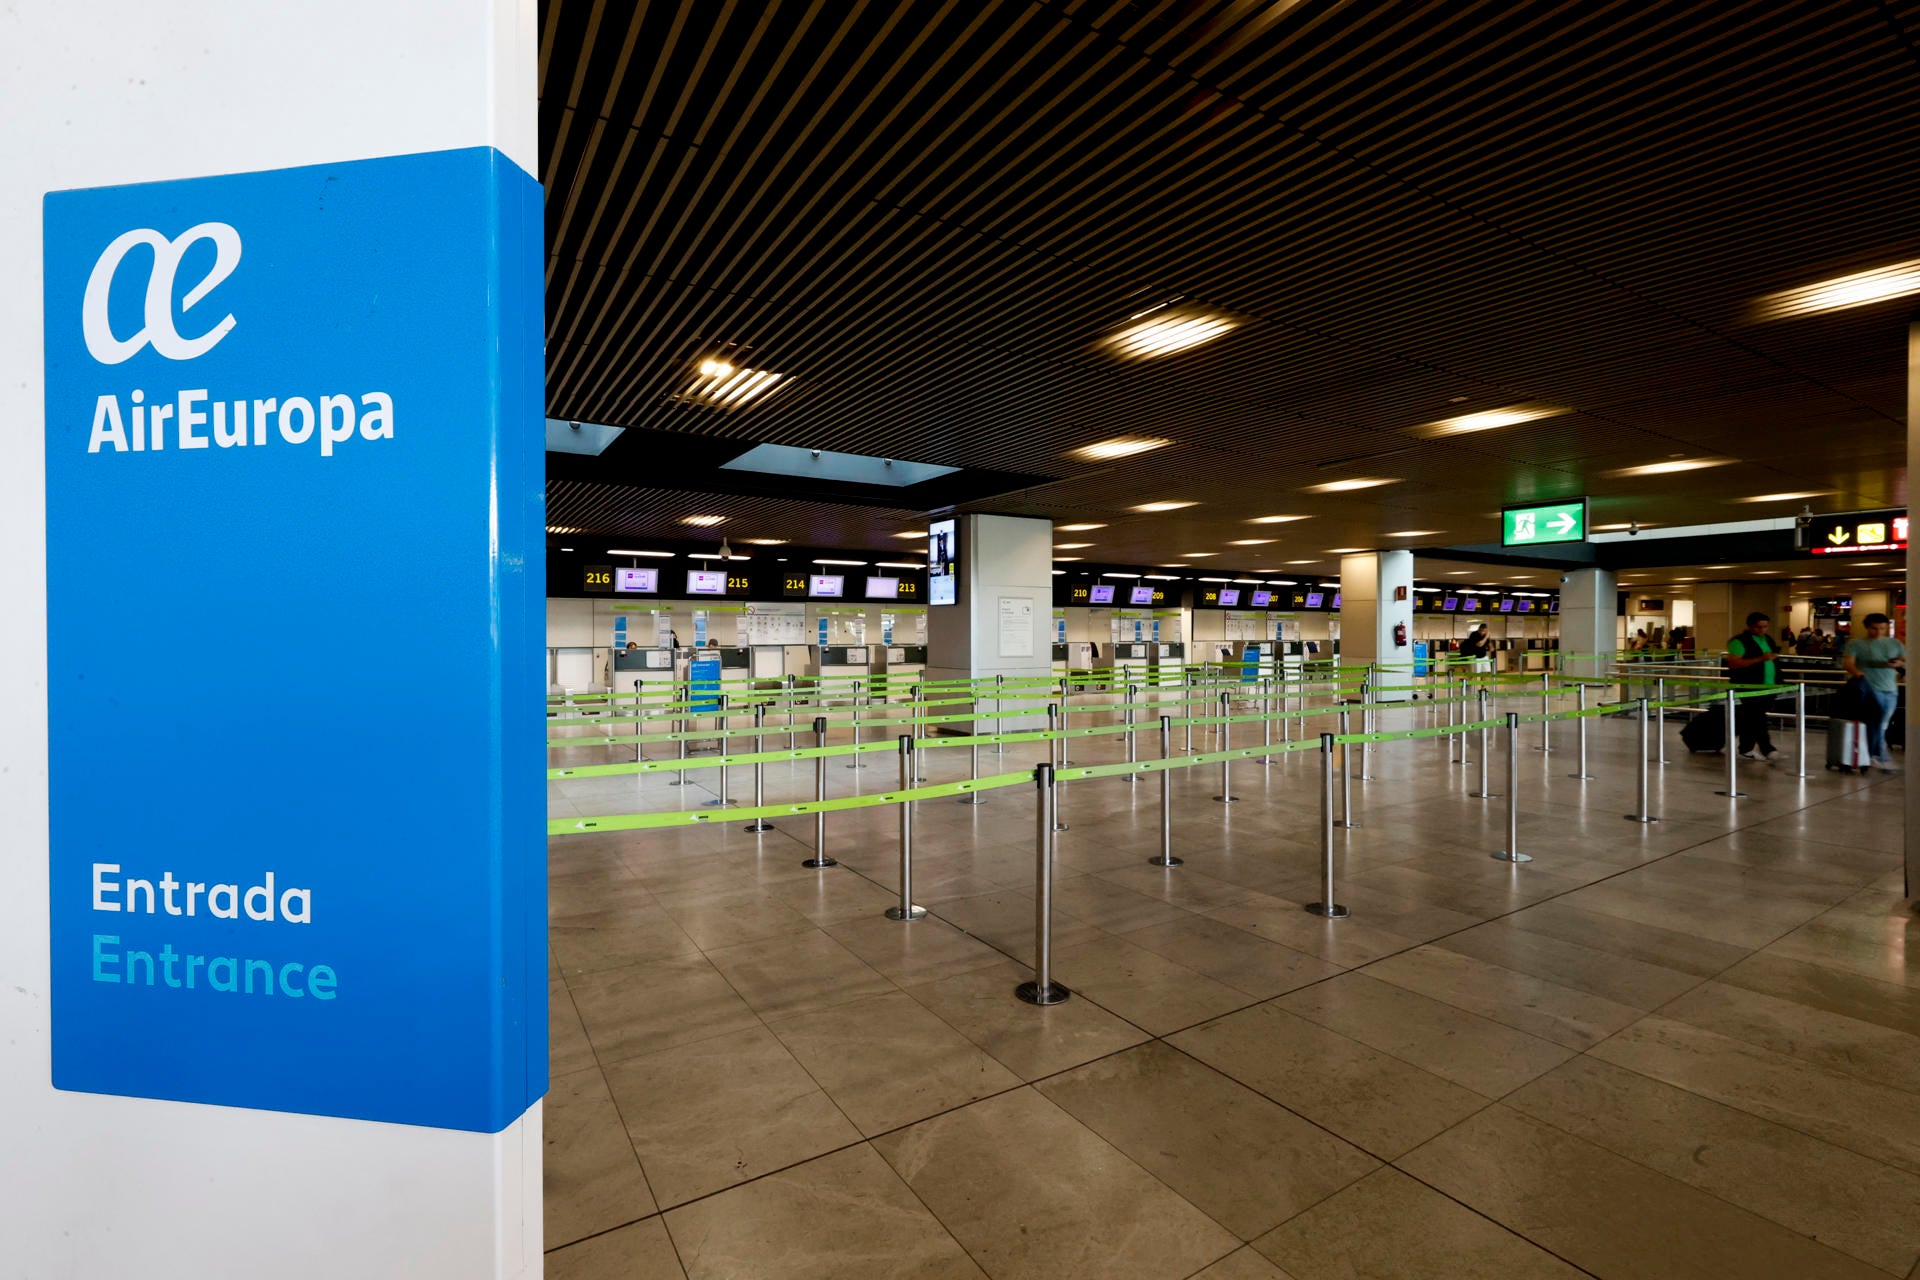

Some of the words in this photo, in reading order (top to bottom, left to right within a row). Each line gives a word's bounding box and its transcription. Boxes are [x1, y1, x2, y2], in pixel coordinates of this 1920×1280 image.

[87, 388, 394, 457] AirEuropa
[586, 572, 610, 584] 216
[728, 577, 749, 588] 215
[786, 579, 805, 589] 214
[898, 583, 916, 593] 213
[1073, 589, 1088, 597] 210
[92, 863, 312, 924] Entrada
[92, 933, 338, 1000] Entrance
